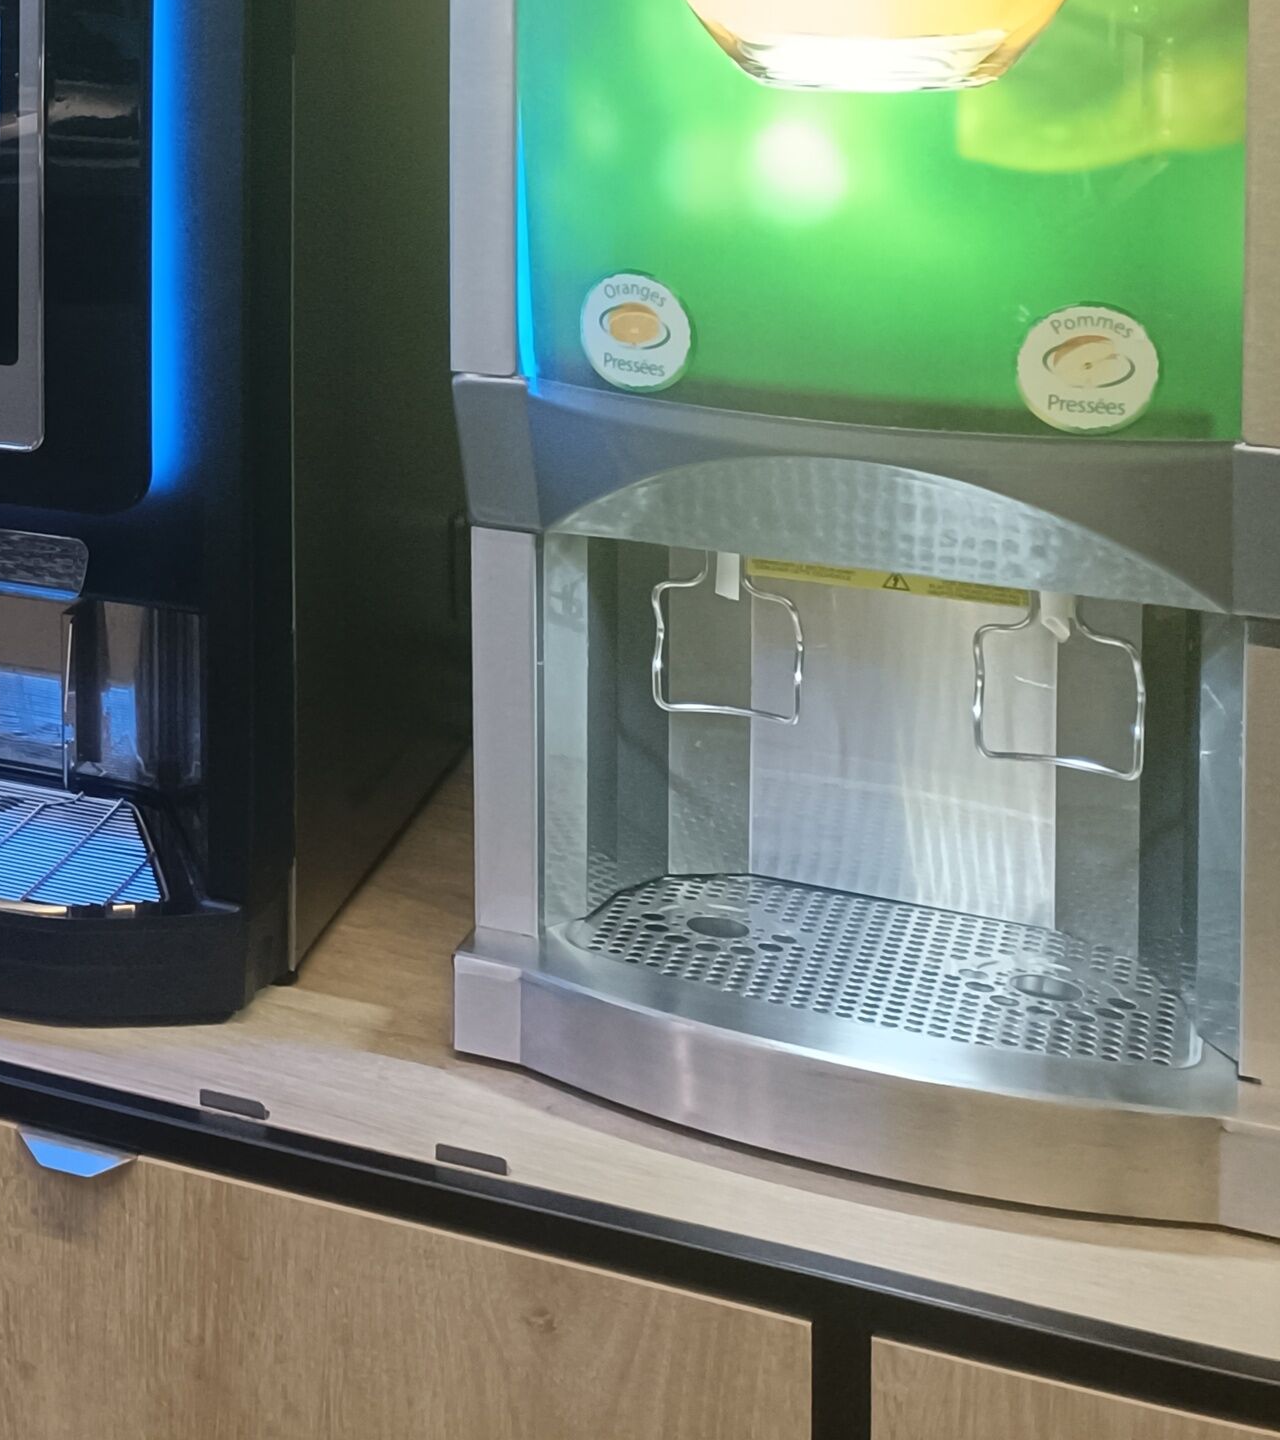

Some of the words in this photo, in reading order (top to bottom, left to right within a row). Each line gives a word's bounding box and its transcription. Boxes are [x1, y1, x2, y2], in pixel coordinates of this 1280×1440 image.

[603, 283, 667, 308] Oranges
[1050, 315, 1134, 339] Pommes
[603, 352, 665, 377] Pressées
[1048, 394, 1126, 415] Pressées
